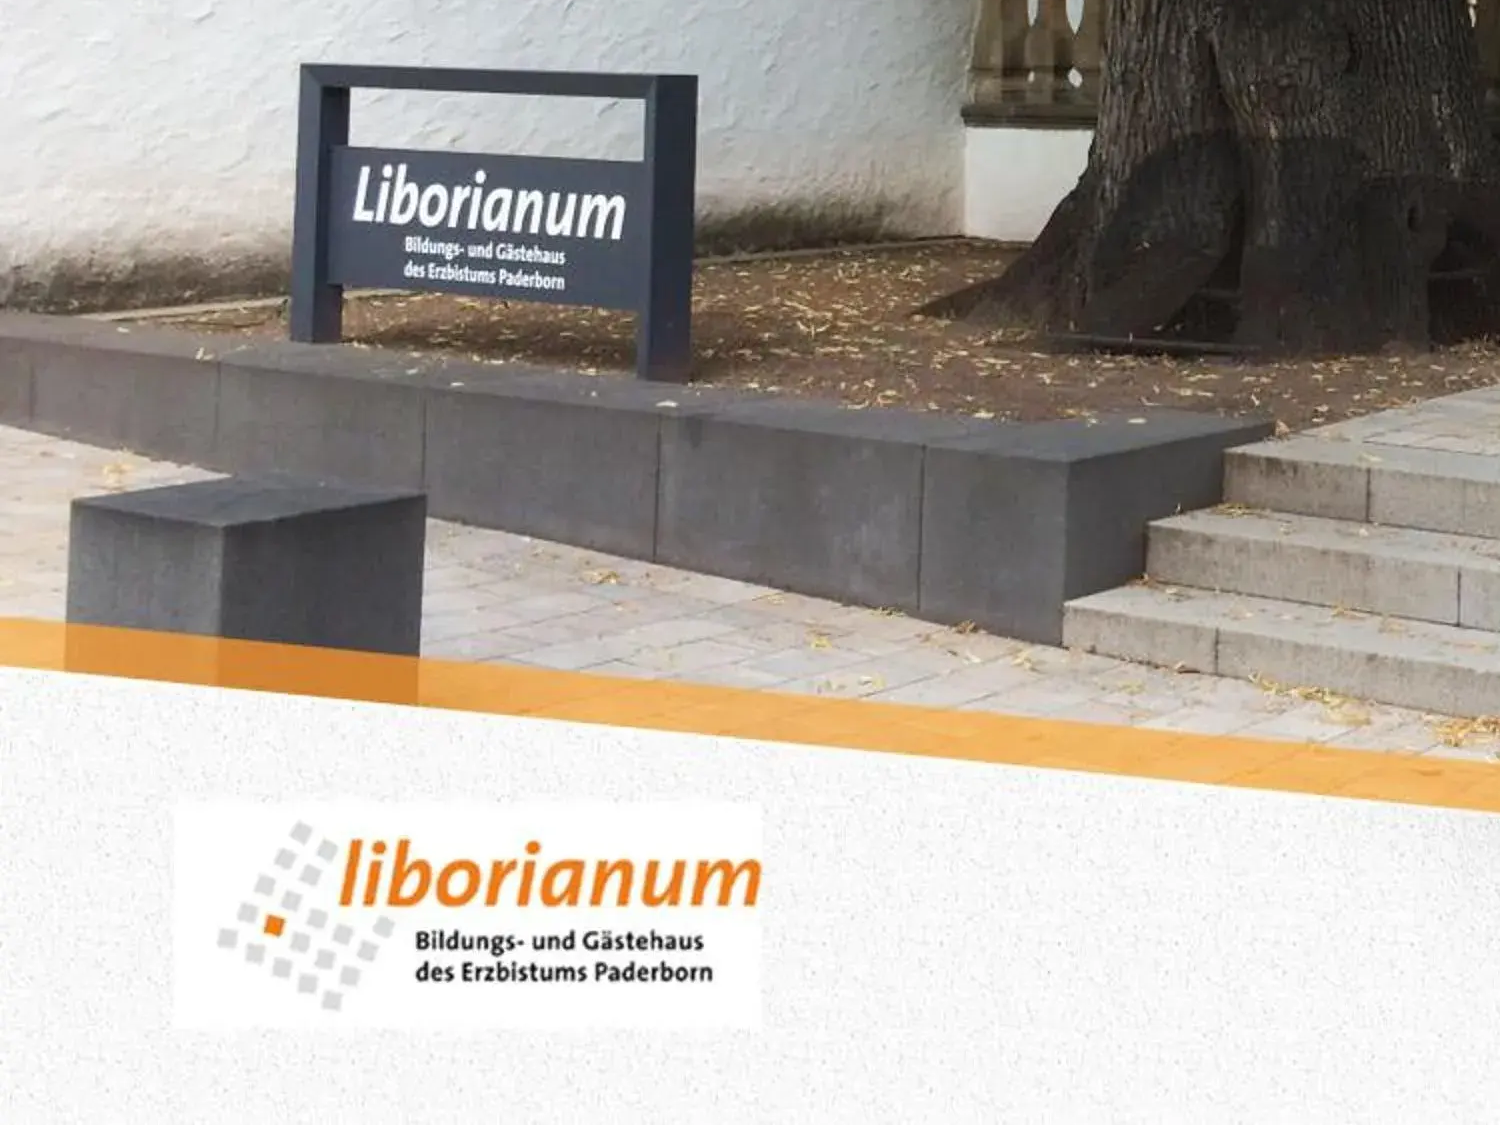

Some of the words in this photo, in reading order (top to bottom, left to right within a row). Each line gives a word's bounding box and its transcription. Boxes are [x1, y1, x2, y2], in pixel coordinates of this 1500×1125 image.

[352, 163, 626, 240] Liborianum
[405, 235, 464, 260] Bildungs-
[467, 240, 493, 259] und
[496, 243, 566, 265] Gästehaus
[403, 260, 425, 279] des
[427, 262, 496, 284] Erzbistums
[499, 267, 566, 290] Paderborn
